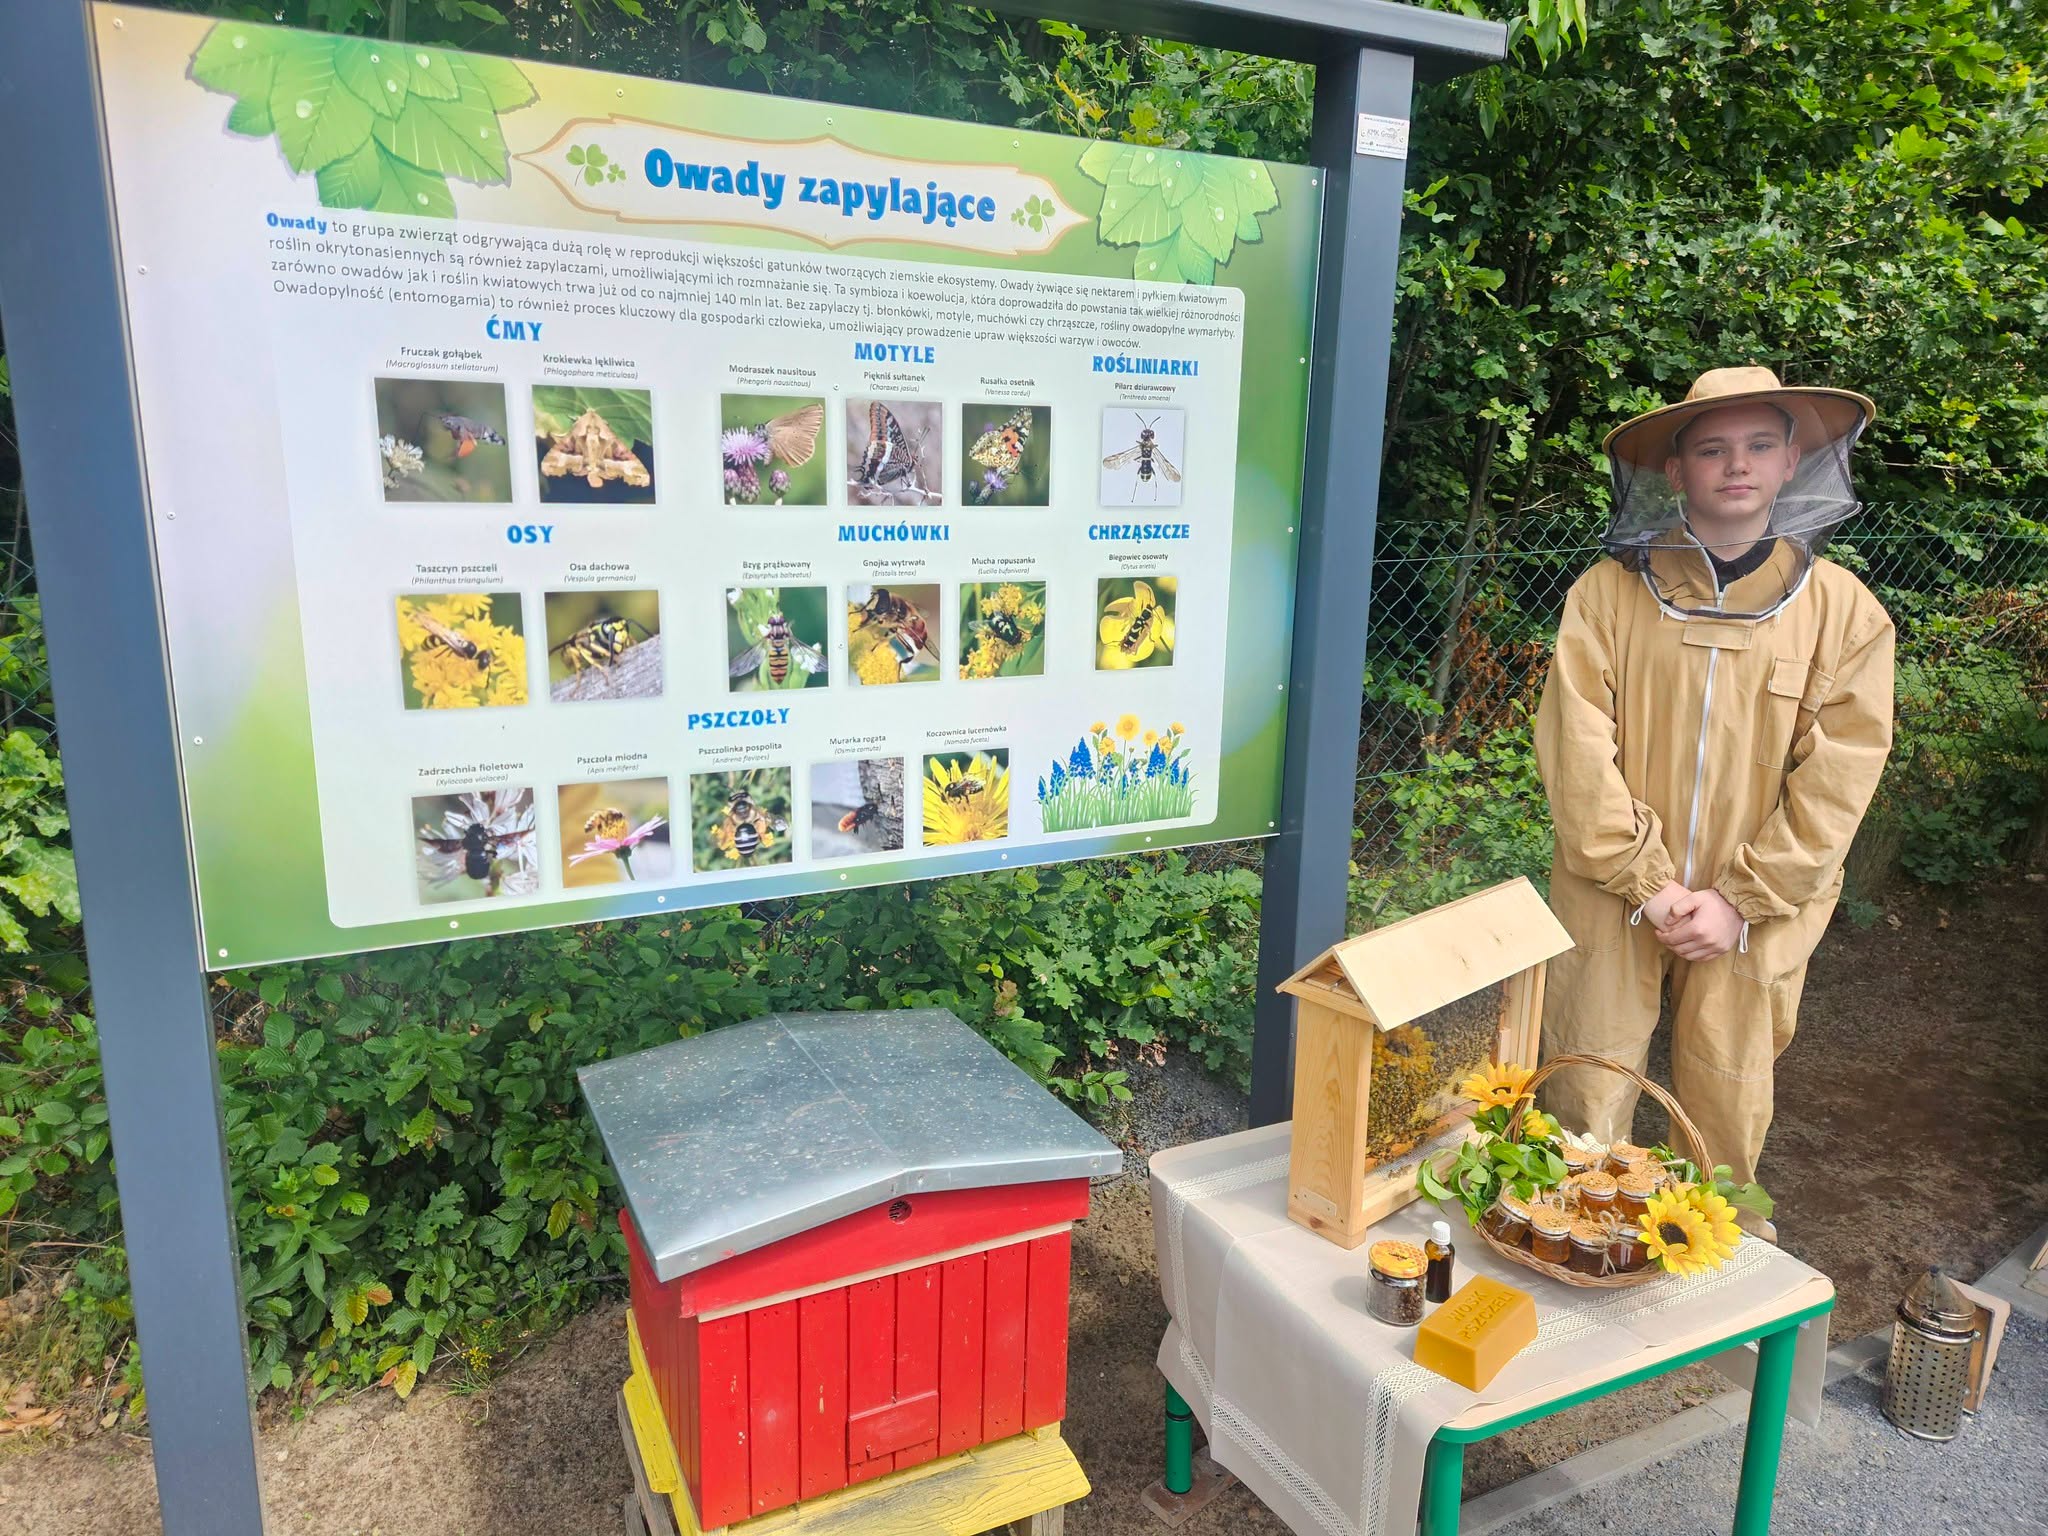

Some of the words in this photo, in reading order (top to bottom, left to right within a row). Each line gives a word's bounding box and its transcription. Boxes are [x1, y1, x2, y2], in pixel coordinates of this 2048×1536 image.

[644, 147, 786, 210] Owady
[799, 175, 996, 228] zapylające
[266, 212, 327, 234] Owady
[332, 220, 347, 233] to
[352, 223, 394, 239] grupa
[399, 227, 457, 244] zwierząt
[462, 232, 547, 252] odgrywająca
[552, 239, 582, 256] dużą
[587, 243, 611, 259] rolę
[615, 247, 625, 257] w
[630, 247, 700, 266] reprodukcji
[703, 253, 764, 269] większości
[767, 258, 822, 274] gatunków
[825, 264, 886, 280] tworzących
[890, 268, 934, 283] ziemskie
[937, 273, 997, 289] ekosystemy.
[1000, 278, 1034, 293] Owady
[1036, 281, 1073, 295] żywiące
[1076, 284, 1088, 297] się
[1091, 286, 1135, 299] nektarem
[1142, 290, 1176, 303] pyłkiem
[1179, 292, 1227, 305] kwiatowym
[269, 236, 311, 251] roślin
[316, 240, 445, 263] okrytonasiennych
[450, 252, 464, 267] są
[469, 253, 522, 269] również
[526, 260, 608, 278] zapylaczami,
[612, 264, 714, 285] umożliwiającymi
[717, 272, 734, 286] ich
[737, 275, 809, 291] rozmnażanie
[813, 282, 831, 296] się.
[835, 284, 846, 295] Ta
[849, 286, 898, 300] symbioza
[907, 288, 967, 305] koewolucja,
[971, 293, 996, 305] która
[999, 295, 1063, 311] doprowadziła
[1066, 300, 1078, 312] do
[1081, 302, 1127, 316] powstania
[1130, 305, 1143, 316] tak
[1146, 306, 1179, 320] wielkiej
[1181, 309, 1240, 322] różnorodności
[272, 259, 336, 275] zarówno
[341, 265, 403, 280] owadów
[407, 268, 428, 283] jak
[441, 270, 478, 286] roślin
[483, 274, 562, 293] kwiatowych
[566, 282, 595, 294] trwa
[598, 281, 617, 297] już
[621, 285, 637, 297] od
[640, 289, 655, 299] co
[659, 289, 711, 306] najmniej
[715, 292, 736, 305] 140
[739, 295, 762, 307] mln
[765, 296, 783, 309] lat.
[786, 298, 806, 310] Bez
[809, 301, 860, 316] zapylaczy
[863, 303, 873, 317] tj.
[877, 304, 933, 320] błonkówki,
[936, 309, 974, 324] motyle,
[977, 312, 1027, 326] muchówki
[1029, 317, 1044, 329] czy
[1047, 318, 1098, 332] chrząszcze,
[1100, 320, 1130, 333] rośliny
[1132, 323, 1185, 336] owadopylne
[1188, 326, 1236, 339] wymarłyby.
[274, 279, 383, 300] Owadopylność
[388, 288, 496, 310] (entomogamia)
[500, 297, 513, 308] to
[518, 295, 570, 312] również
[574, 303, 616, 316] proces
[619, 306, 675, 322] kluczowy
[679, 309, 697, 321] dla
[701, 311, 765, 326] gospodarki
[768, 316, 826, 331] człowieka,
[829, 320, 903, 336] umożliwiający
[907, 325, 971, 339] prowadzenie
[974, 330, 1005, 342] upraw
[1008, 331, 1057, 345] większości
[1060, 336, 1094, 347] warzyw
[1102, 336, 1141, 349] owoców.
[486, 313, 543, 342] ĆMY
[401, 346, 440, 358] Fruczak
[443, 348, 483, 361] gołąbek
[854, 342, 935, 364] MOTYLE
[386, 358, 449, 371] (Macroglossum
[543, 354, 593, 366] Krokiewka
[595, 357, 636, 369] lękliwica
[1092, 352, 1200, 377] ROŚLINIARKI
[729, 364, 775, 375] Modraszek
[777, 366, 817, 377] nausitous
[863, 371, 892, 382] Piękniś
[893, 372, 926, 383] sułtanek
[980, 377, 1008, 386] Rusałka
[1009, 377, 1035, 387] osetnik
[1114, 382, 1133, 391] Pilarz
[1134, 383, 1176, 393] dziurawcowy
[507, 524, 554, 544] OSY
[838, 520, 950, 543] MUCHÓWKI
[1088, 523, 1190, 544] CHRZĄSZCZE
[742, 560, 761, 570] Bzyg
[763, 559, 811, 570] prążkowany
[862, 558, 889, 568] Gnojka
[891, 558, 926, 568] wytrwała
[971, 556, 996, 565] Mucha
[997, 556, 1036, 566] ropuszanka
[1108, 552, 1141, 562] Biegowiec
[1142, 552, 1169, 562] osowaty
[416, 564, 458, 575] Taszczyn
[461, 563, 498, 575] pszczeli
[569, 562, 587, 571] Osa
[589, 562, 630, 571] dachowa
[411, 575, 456, 586] (Philanthus
[458, 574, 504, 585] triangulum)
[687, 707, 791, 731] PSZCZOŁY
[926, 727, 967, 738] Koczownica
[968, 724, 1008, 736] lucernówka
[829, 735, 862, 746] Murarka
[863, 734, 887, 745] rogata
[698, 744, 744, 756] Pszczolinka
[745, 741, 783, 753] pospolita
[576, 754, 613, 765] Pszczoła
[615, 752, 648, 762] miodna
[418, 764, 477, 777] Zadrzechnia
[479, 760, 525, 773] fioletowa
